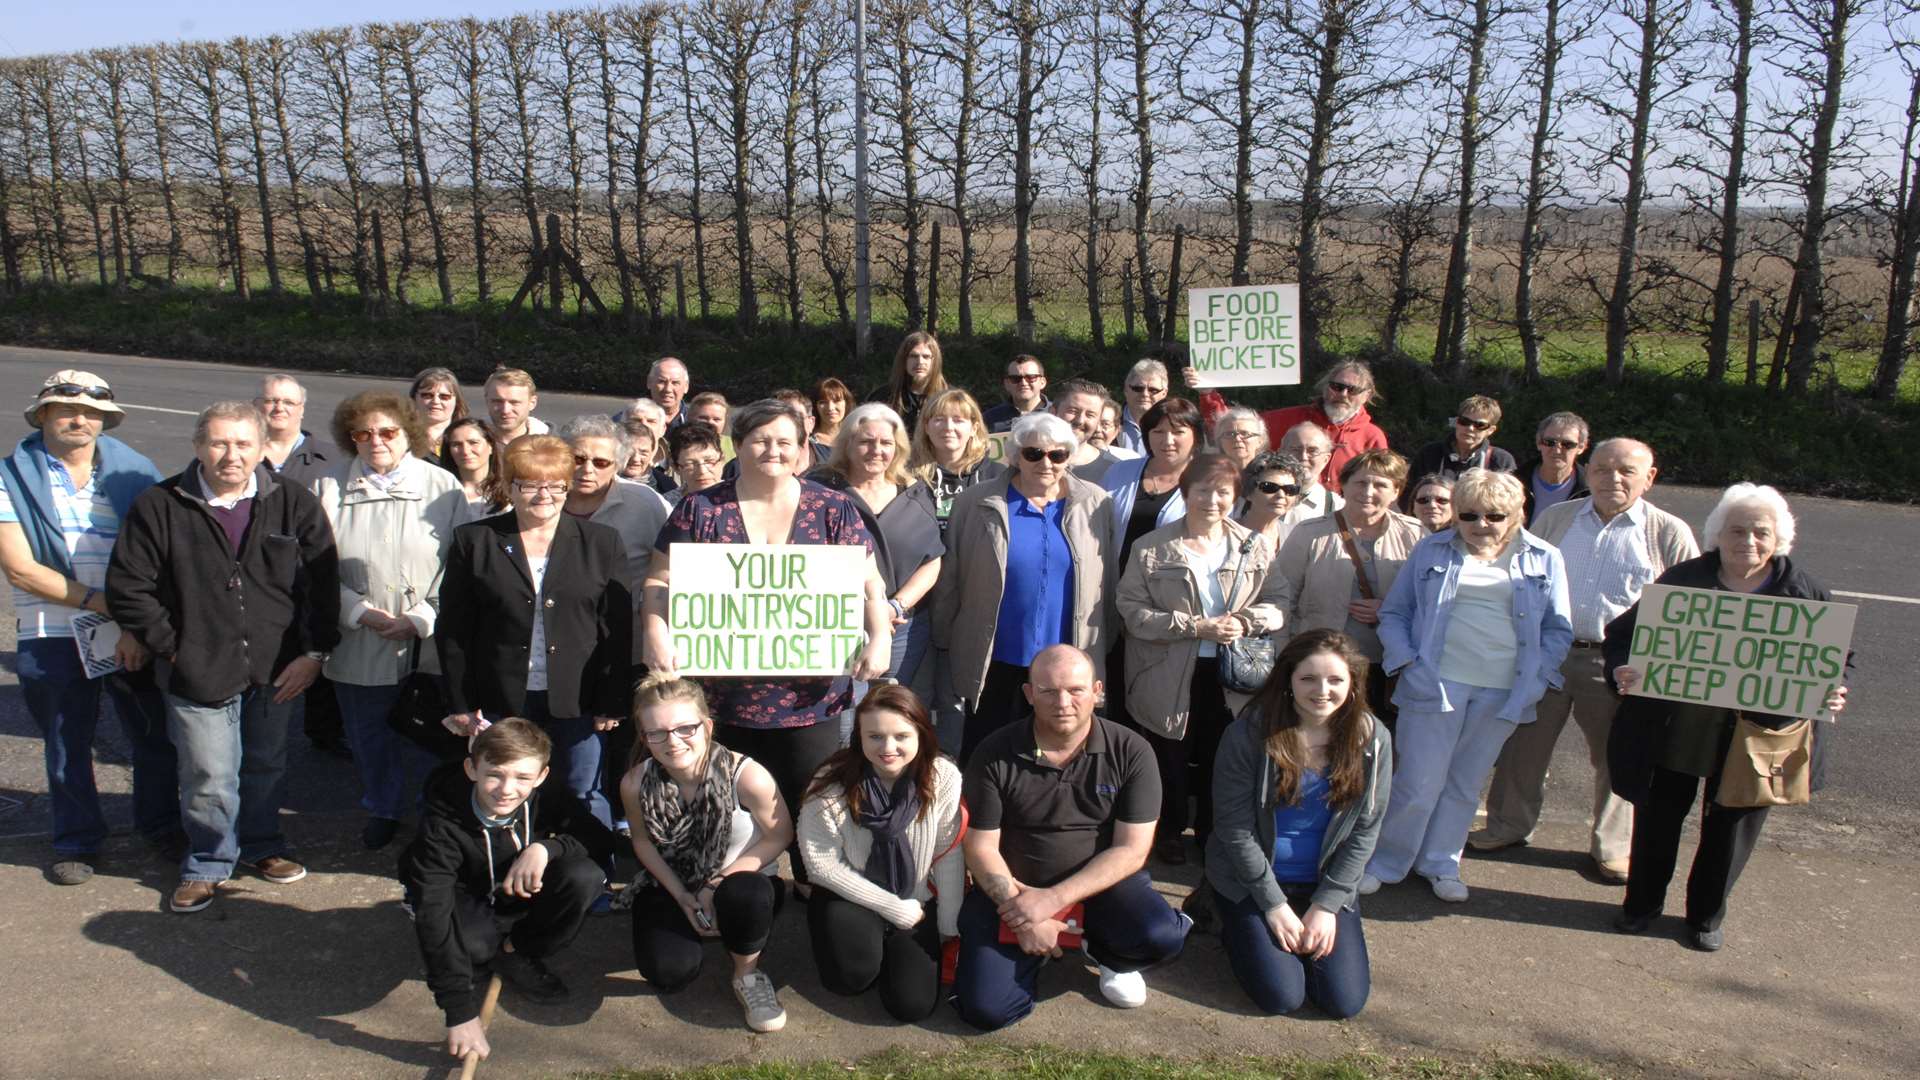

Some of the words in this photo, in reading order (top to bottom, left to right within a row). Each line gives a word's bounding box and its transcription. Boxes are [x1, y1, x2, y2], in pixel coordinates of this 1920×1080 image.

[1208, 291, 1279, 317] FOOD
[1194, 315, 1293, 343] BEFORE
[1191, 343, 1296, 371] WICKETS
[726, 552, 807, 589] YOUR
[671, 592, 859, 630] COUNTRYSIDE
[1662, 591, 1828, 639] GREEDY
[1631, 625, 1842, 679] DEVELOPERS
[1642, 662, 1727, 701] KEEP
[1736, 673, 1835, 716] OUT!
